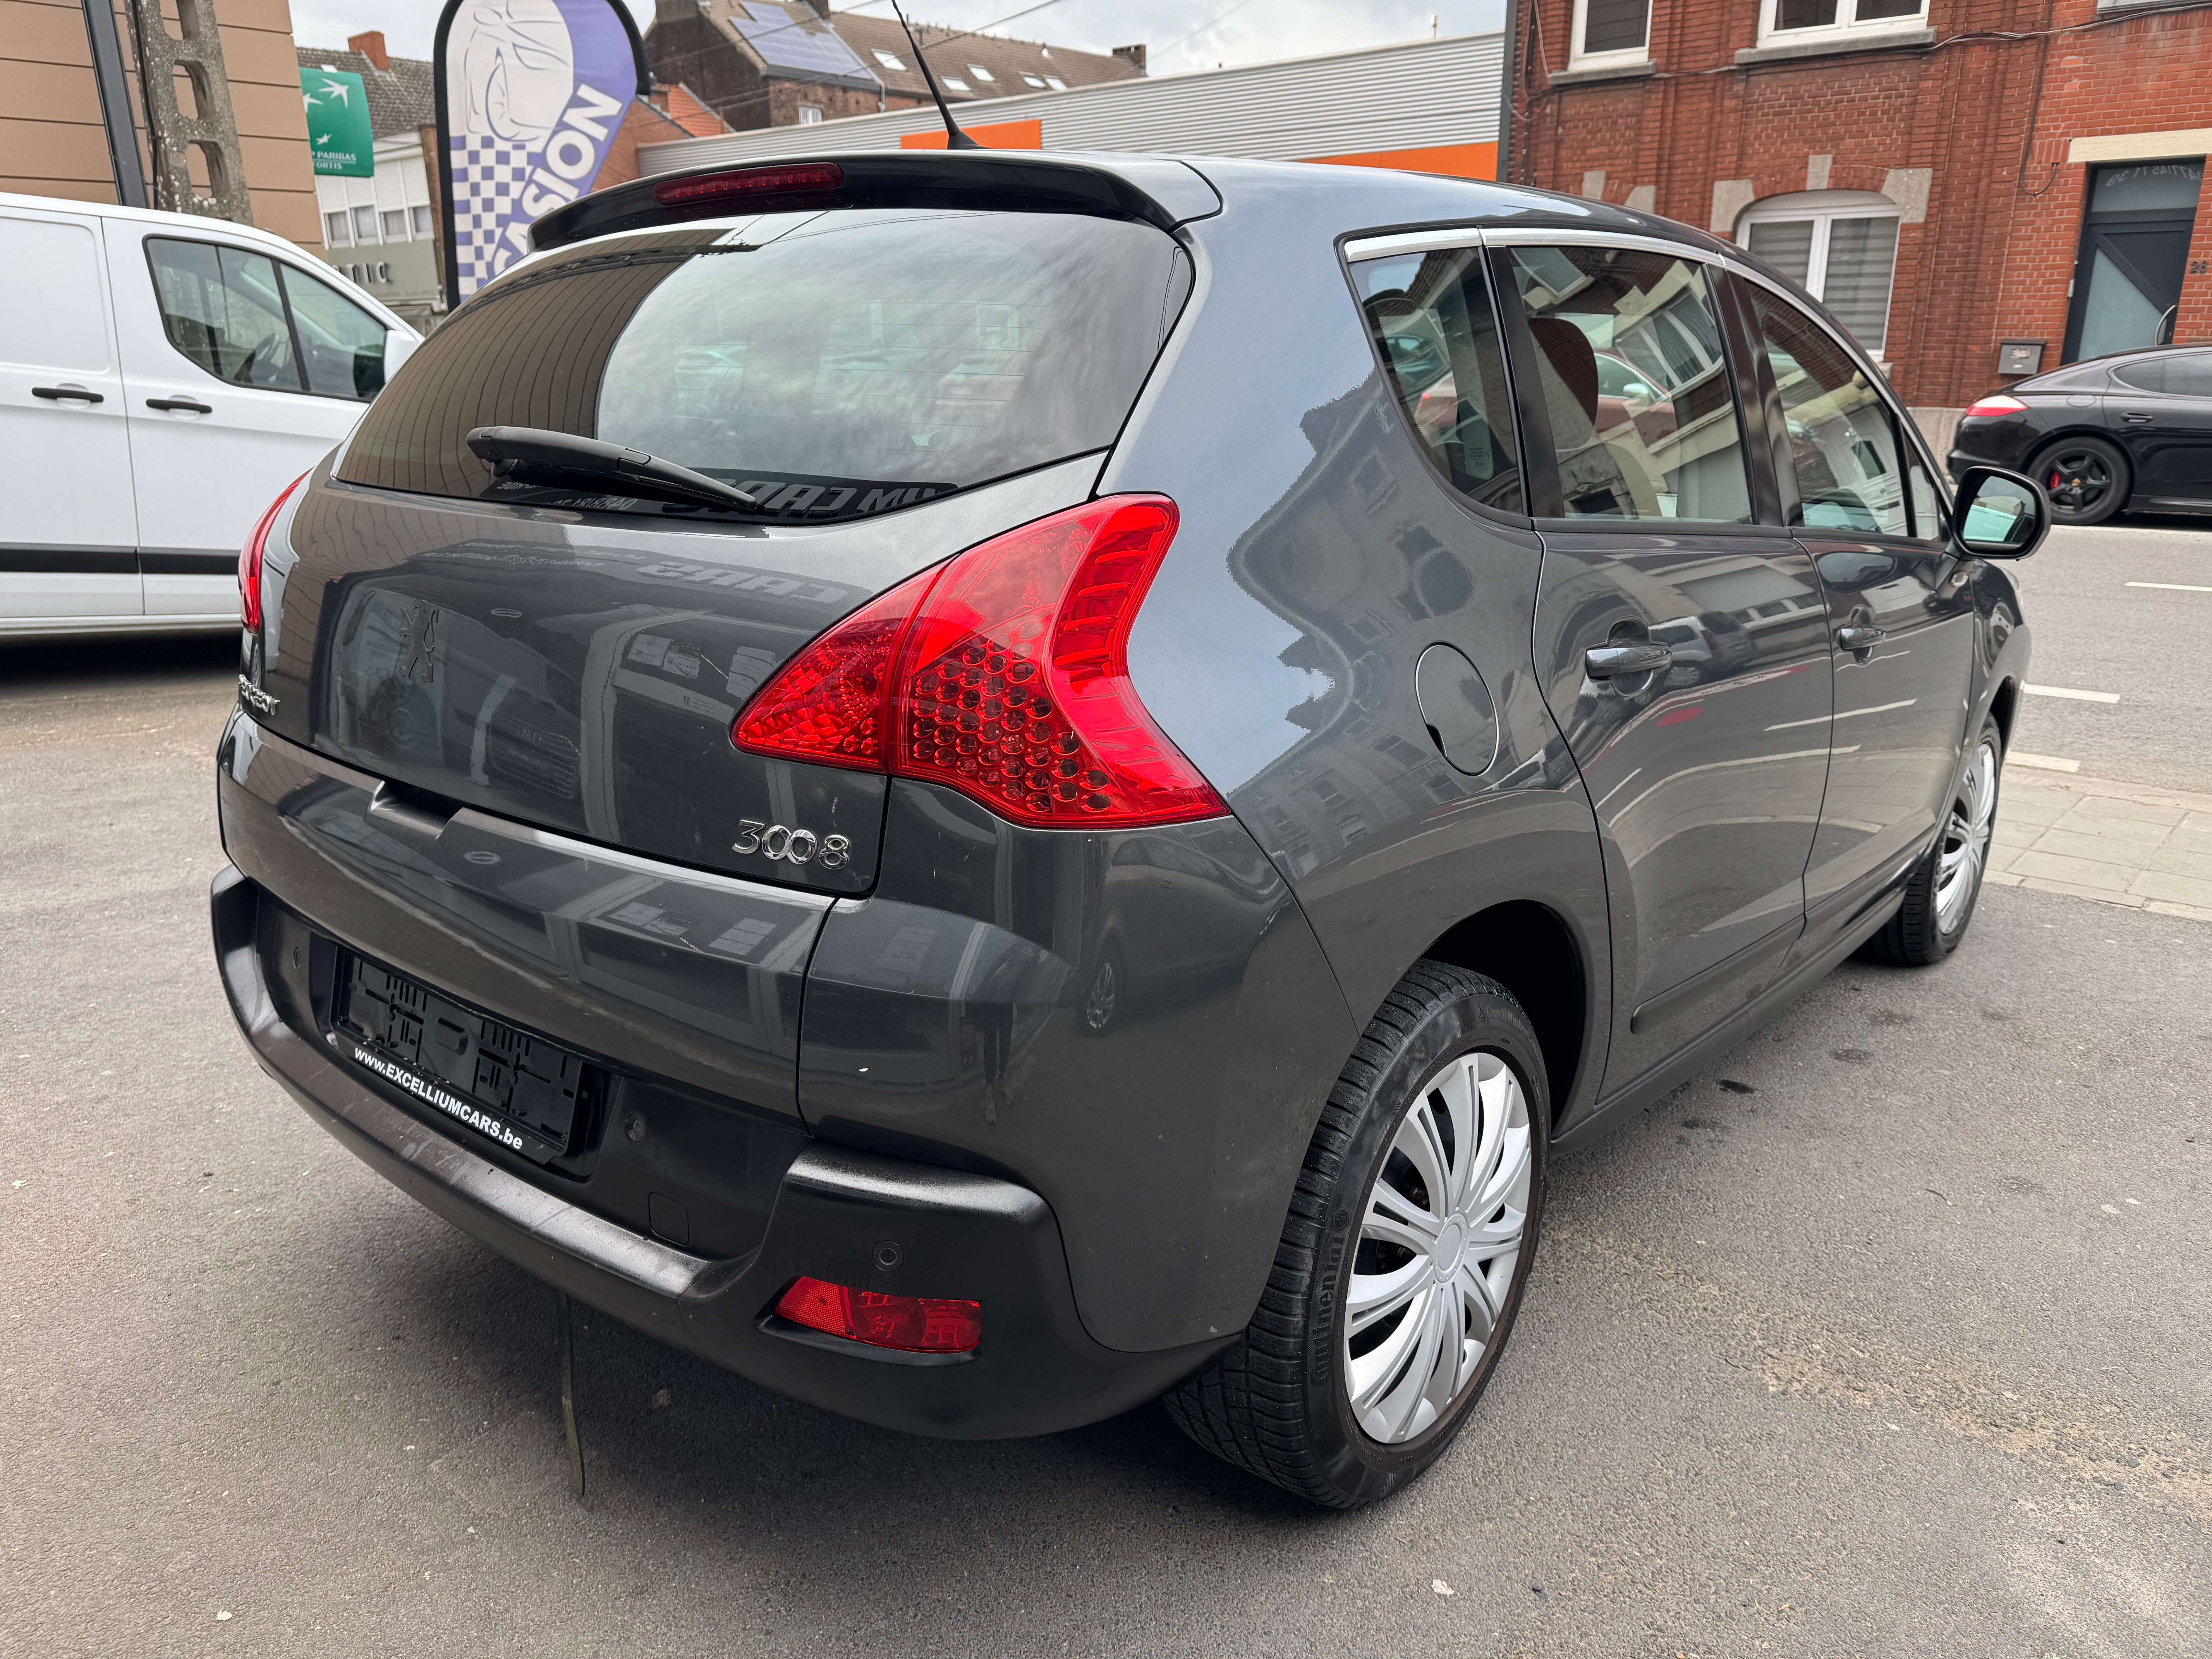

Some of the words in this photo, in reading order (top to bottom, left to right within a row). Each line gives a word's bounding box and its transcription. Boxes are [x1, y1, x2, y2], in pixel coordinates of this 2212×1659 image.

[317, 151, 356, 161] PARIBAS
[313, 161, 342, 170] ORTIS
[333, 261, 387, 283] TIC
[2190, 261, 2209, 274] 26
[732, 819, 851, 870] 3008
[354, 1047, 523, 1150] www.EXCELLIUMCARS.be
